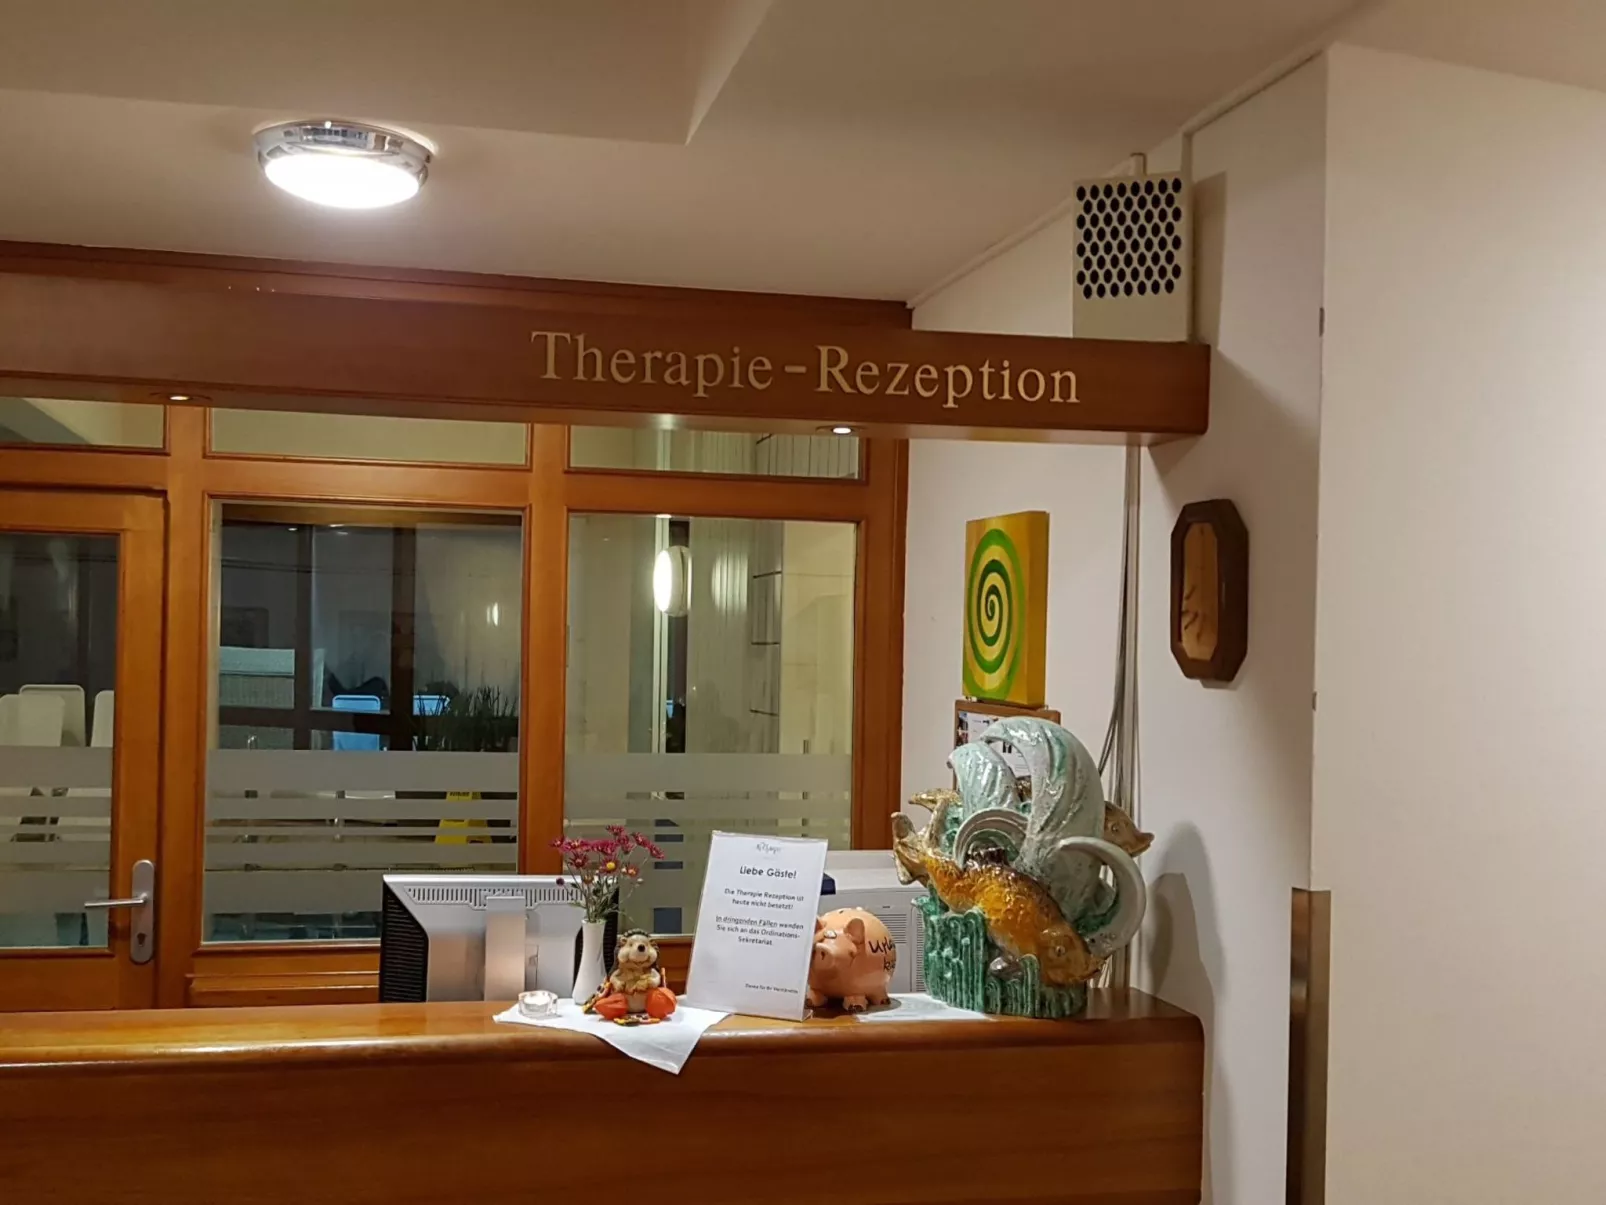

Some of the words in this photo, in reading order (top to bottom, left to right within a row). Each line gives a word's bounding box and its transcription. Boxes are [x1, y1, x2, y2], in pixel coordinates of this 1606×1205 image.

[739, 865, 764, 876] Liebe
[766, 867, 797, 879] Gäste!
[724, 887, 735, 895] Die
[736, 889, 763, 898] Therapie
[763, 891, 796, 902] Rezeption
[732, 898, 750, 906] heute
[750, 900, 767, 908] nicht
[723, 916, 758, 926] dringenden
[758, 919, 778, 927] Fällen
[779, 921, 804, 930] wenden
[716, 924, 726, 932] Sie
[727, 925, 739, 933] sich
[748, 927, 760, 935] das
[760, 928, 801, 940] Ordinations-
